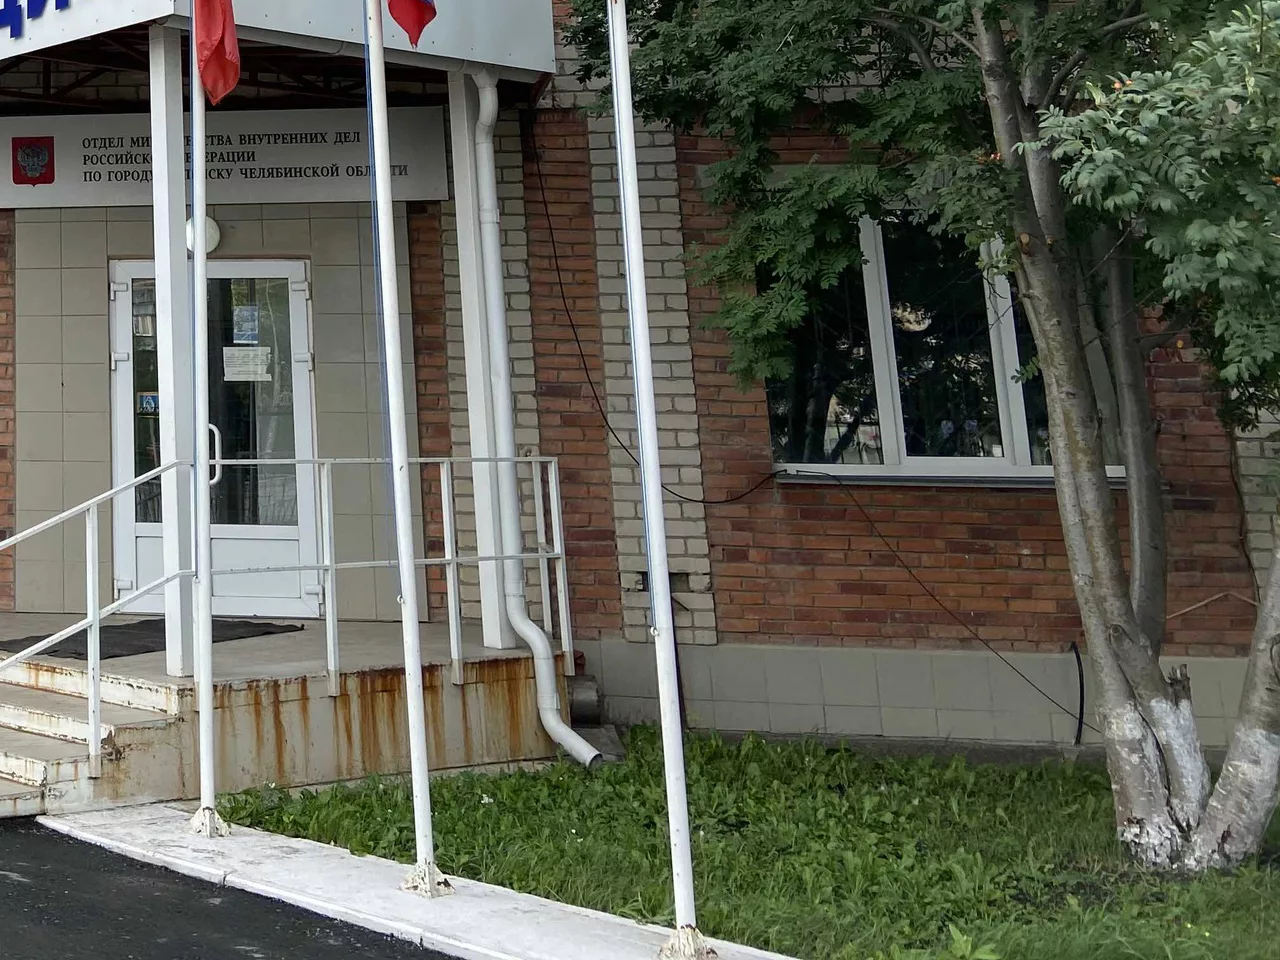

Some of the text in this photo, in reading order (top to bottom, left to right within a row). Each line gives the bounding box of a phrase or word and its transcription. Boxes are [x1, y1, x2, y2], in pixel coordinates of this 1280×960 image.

[82, 136, 125, 150] ОТДЕЛ
[239, 132, 328, 146] ВНУТРЕННИХ
[333, 131, 361, 145] ДЕЛ
[83, 150, 152, 166] РОССИЙСК
[83, 170, 102, 182] ПО
[239, 163, 340, 179] ЧЕЛЯБИНСКОЙ
[345, 164, 409, 177] ОБЛТИ
